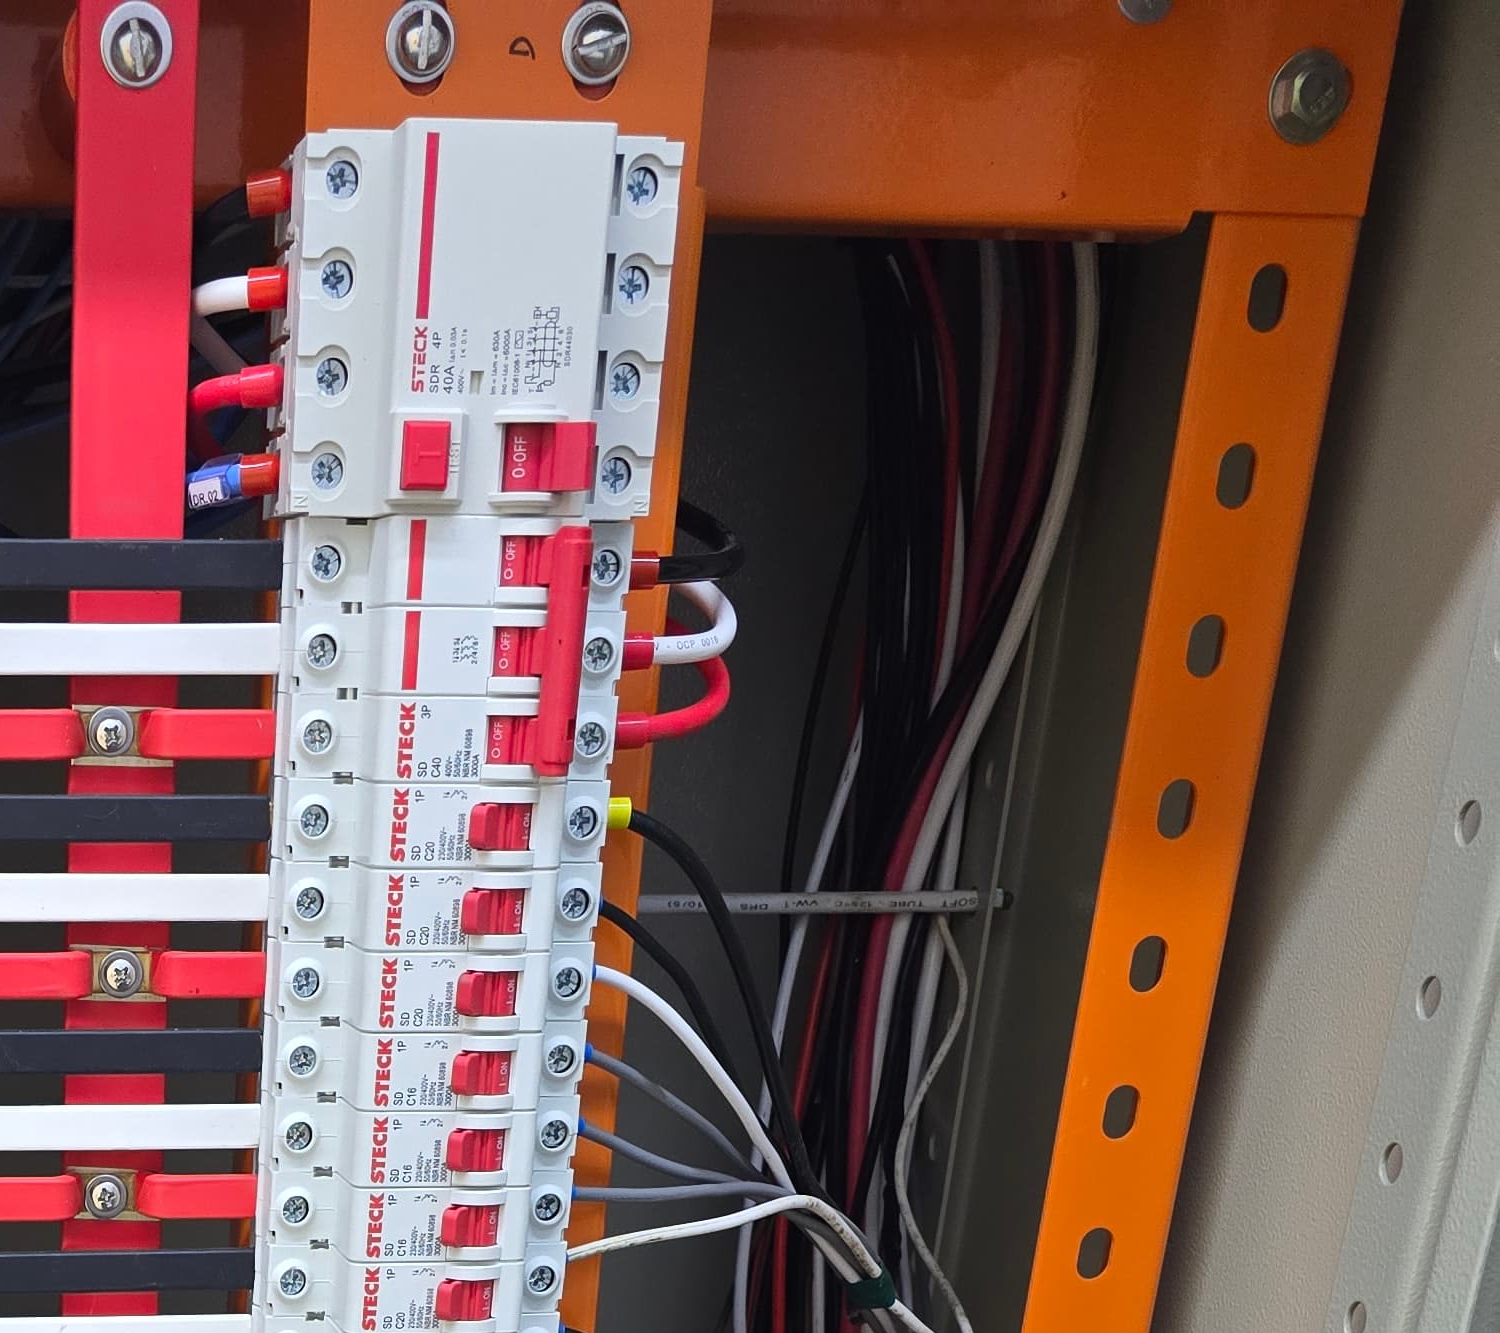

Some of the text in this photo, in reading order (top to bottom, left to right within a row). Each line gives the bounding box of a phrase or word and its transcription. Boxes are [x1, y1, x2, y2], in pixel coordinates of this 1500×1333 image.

[411, 326, 429, 393] STECK
[429, 332, 442, 393] SDR 4P
[443, 365, 456, 394] 40A
[397, 703, 416, 778] STECK
[417, 705, 431, 777] SD 3P
[431, 758, 441, 777] C40
[390, 789, 410, 861] STECK
[411, 790, 424, 861] SD 1P
[424, 842, 435, 861] C20
[385, 875, 405, 945] STECK
[406, 877, 419, 944] SD 1P
[419, 927, 429, 945] C20
[379, 958, 398, 1028] STECK
[400, 960, 413, 1026] SD 1P
[413, 1009, 423, 1027] C20
[374, 1039, 393, 1106] STECK
[393, 1041, 406, 1105] SD 1P
[406, 1088, 416, 1106] C16
[371, 1118, 389, 1183] STECK
[390, 1119, 402, 1182] SD 1P
[403, 1165, 412, 1183] C16
[366, 1195, 384, 1258] STECK
[384, 1195, 396, 1256] SD 1P
[397, 1240, 406, 1256] C16
[361, 1268, 380, 1330] STECK
[383, 1269, 395, 1329] SD 1P
[395, 1312, 405, 1329] C20
